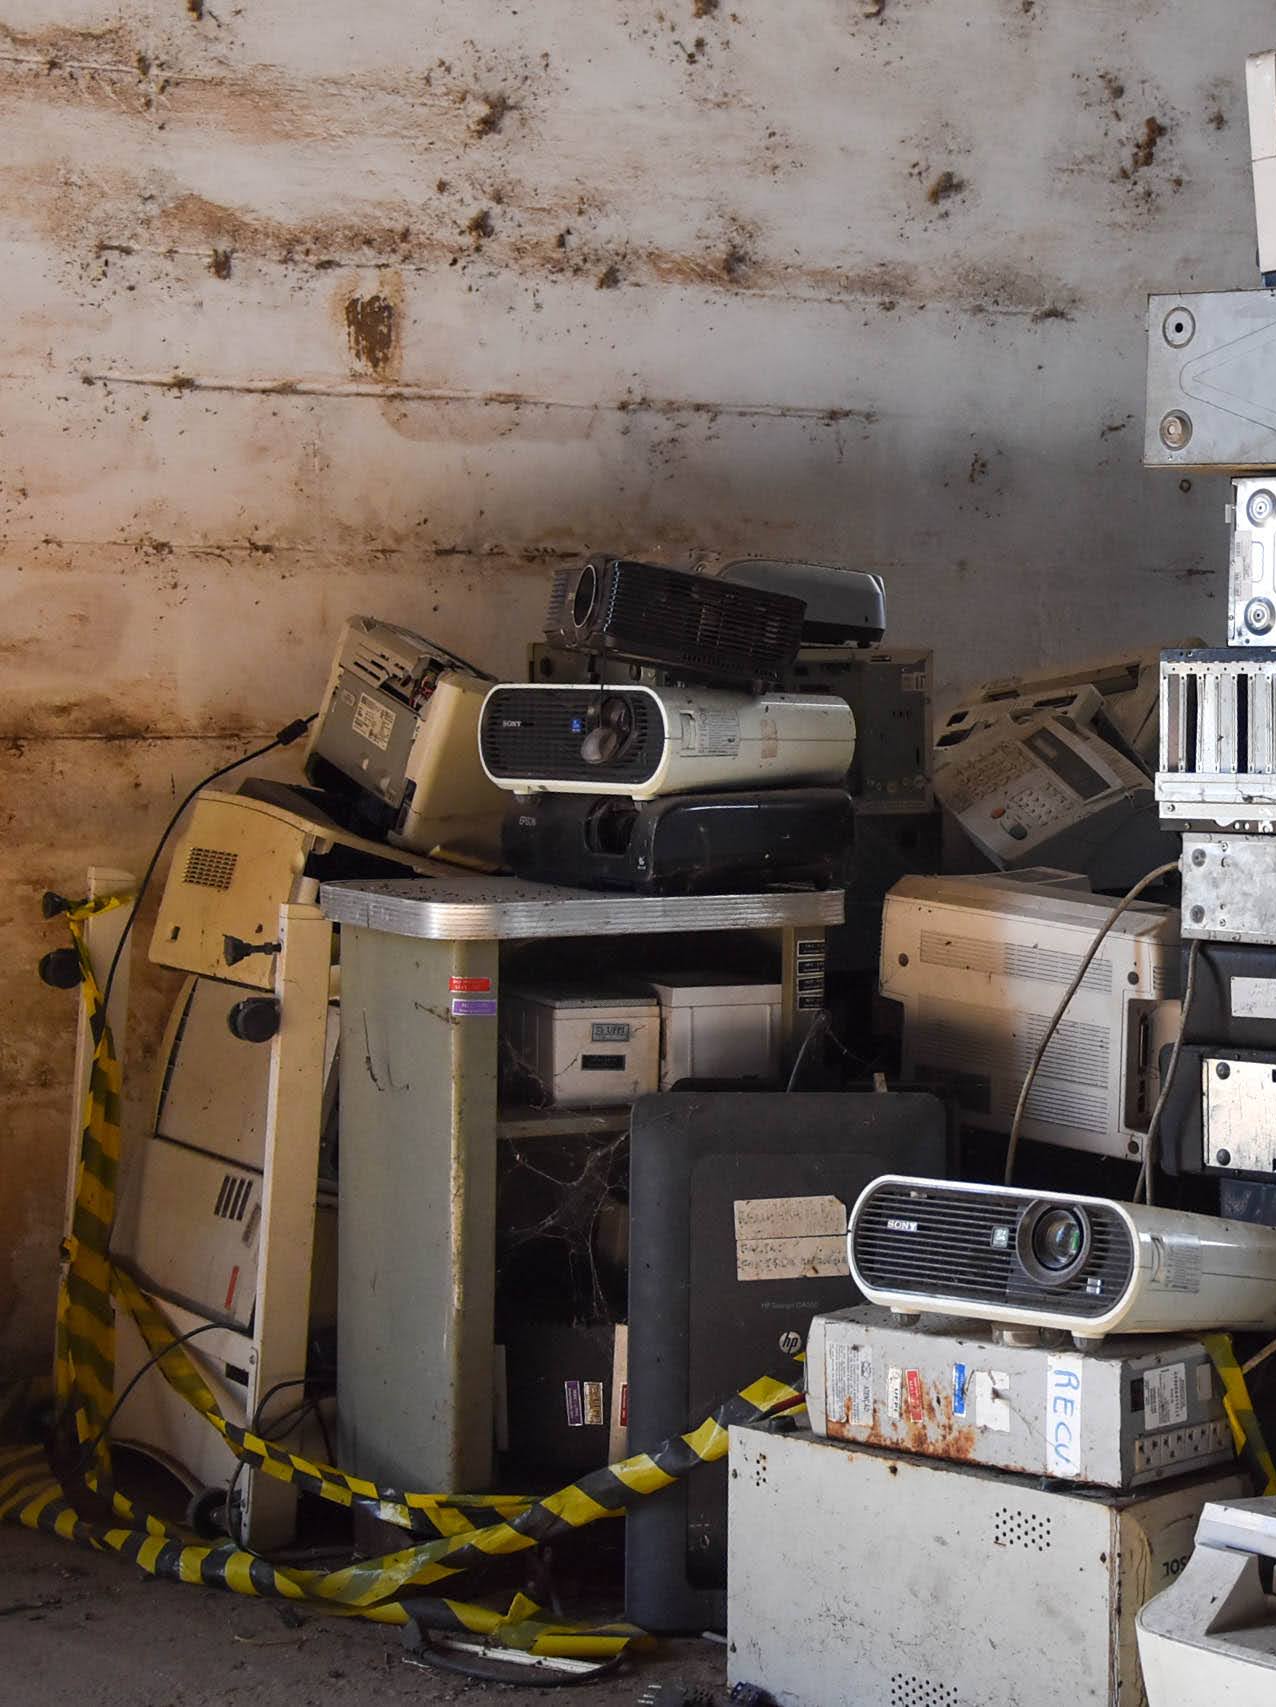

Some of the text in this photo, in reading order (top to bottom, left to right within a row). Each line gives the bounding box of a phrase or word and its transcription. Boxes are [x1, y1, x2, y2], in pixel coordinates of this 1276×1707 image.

[502, 719, 522, 728] SONY
[887, 1219, 918, 1232] SONY
[781, 1331, 799, 1354] hp
[1051, 1367, 1081, 1465] RECU
